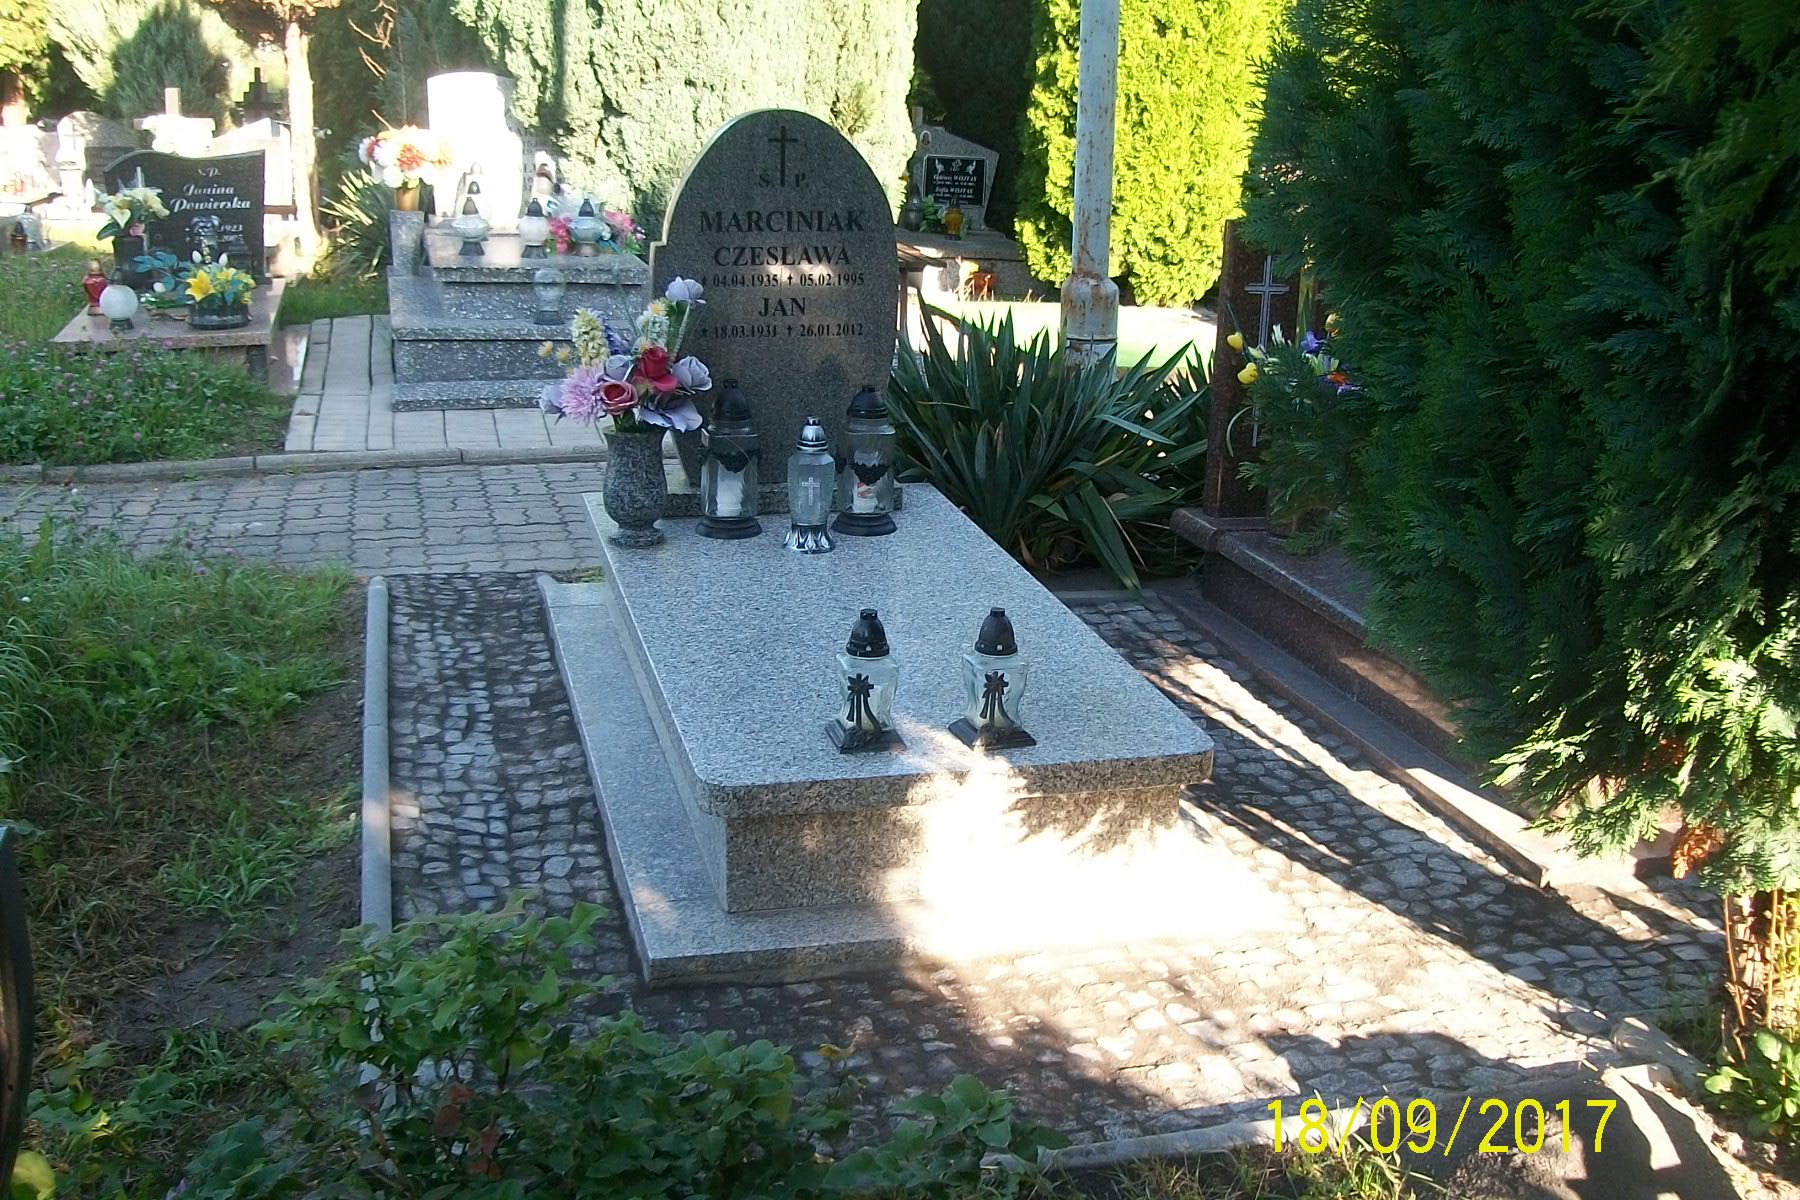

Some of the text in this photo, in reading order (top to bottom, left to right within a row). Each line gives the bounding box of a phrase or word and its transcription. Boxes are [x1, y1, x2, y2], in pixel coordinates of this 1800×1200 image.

[183, 184, 234, 196] Janina
[170, 196, 251, 213] Powierska
[700, 210, 865, 233] MARCINIAK
[713, 272, 864, 288] 04.04.1935 05.02.1995
[758, 297, 806, 317] JAN
[800, 323, 863, 337] 26.01.2012
